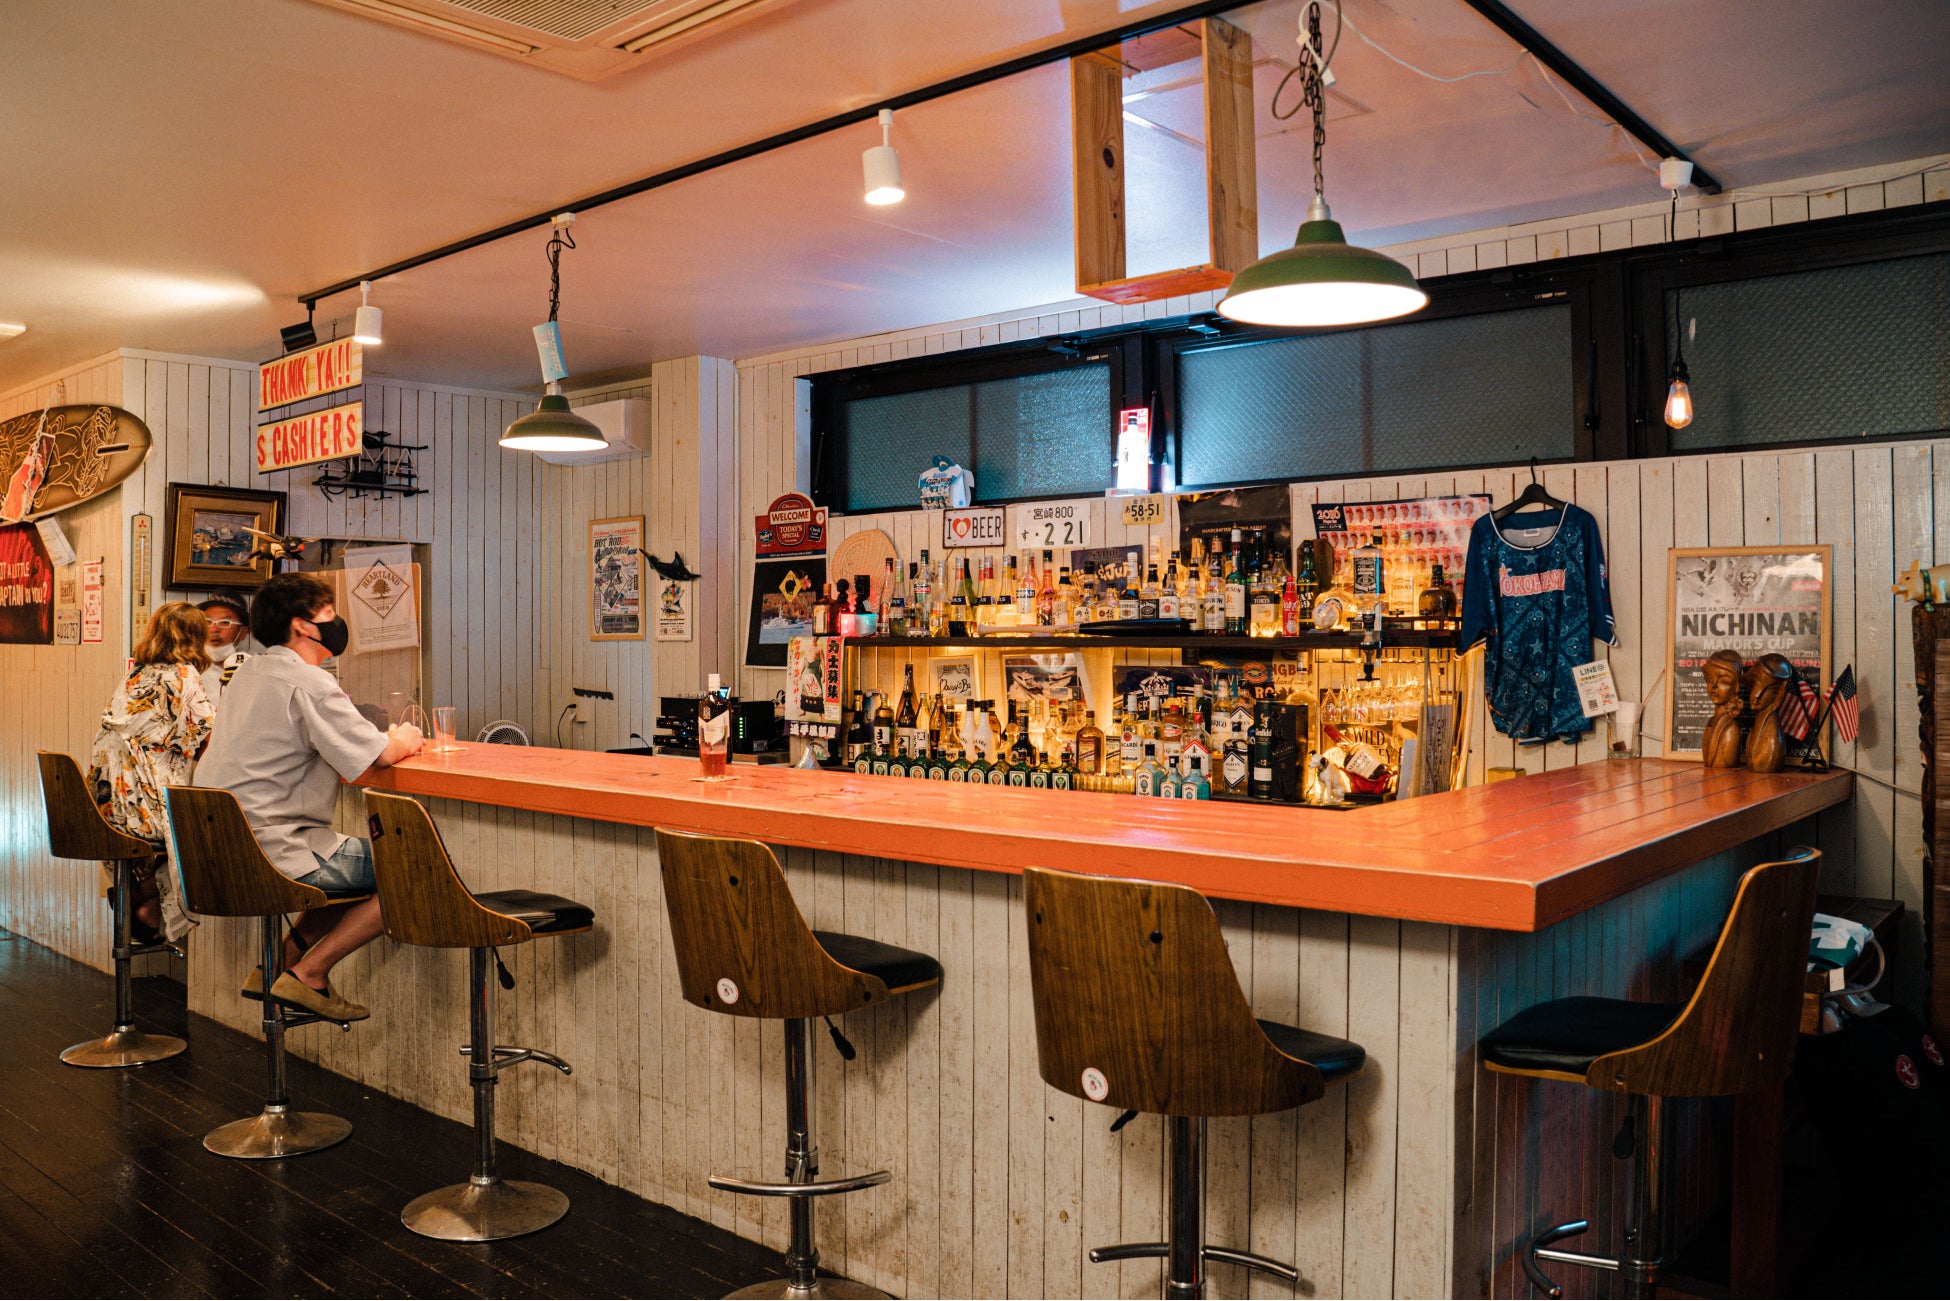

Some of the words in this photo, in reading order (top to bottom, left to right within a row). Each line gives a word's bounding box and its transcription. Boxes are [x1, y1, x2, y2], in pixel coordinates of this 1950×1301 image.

[262, 356, 308, 406] THANK
[316, 342, 351, 391] YA!!
[257, 434, 266, 466] S
[272, 412, 357, 466] CASHIERS
[771, 510, 809, 522] WELCOME
[1033, 507, 1054, 520] 宮崎
[1054, 505, 1074, 519] 800
[780, 524, 803, 533] TODAY'S
[947, 518, 952, 539] I
[972, 515, 1002, 538] BEER
[594, 537, 607, 548] HOT
[608, 536, 622, 547] ROD
[361, 570, 400, 589] HEARTLAND
[1681, 612, 1818, 637] NICHINAN
[1703, 637, 1763, 650] MAYOR'S
[1767, 637, 1796, 650] CUP
[827, 639, 840, 699] 力士募集
[1354, 728, 1385, 746] WILD
